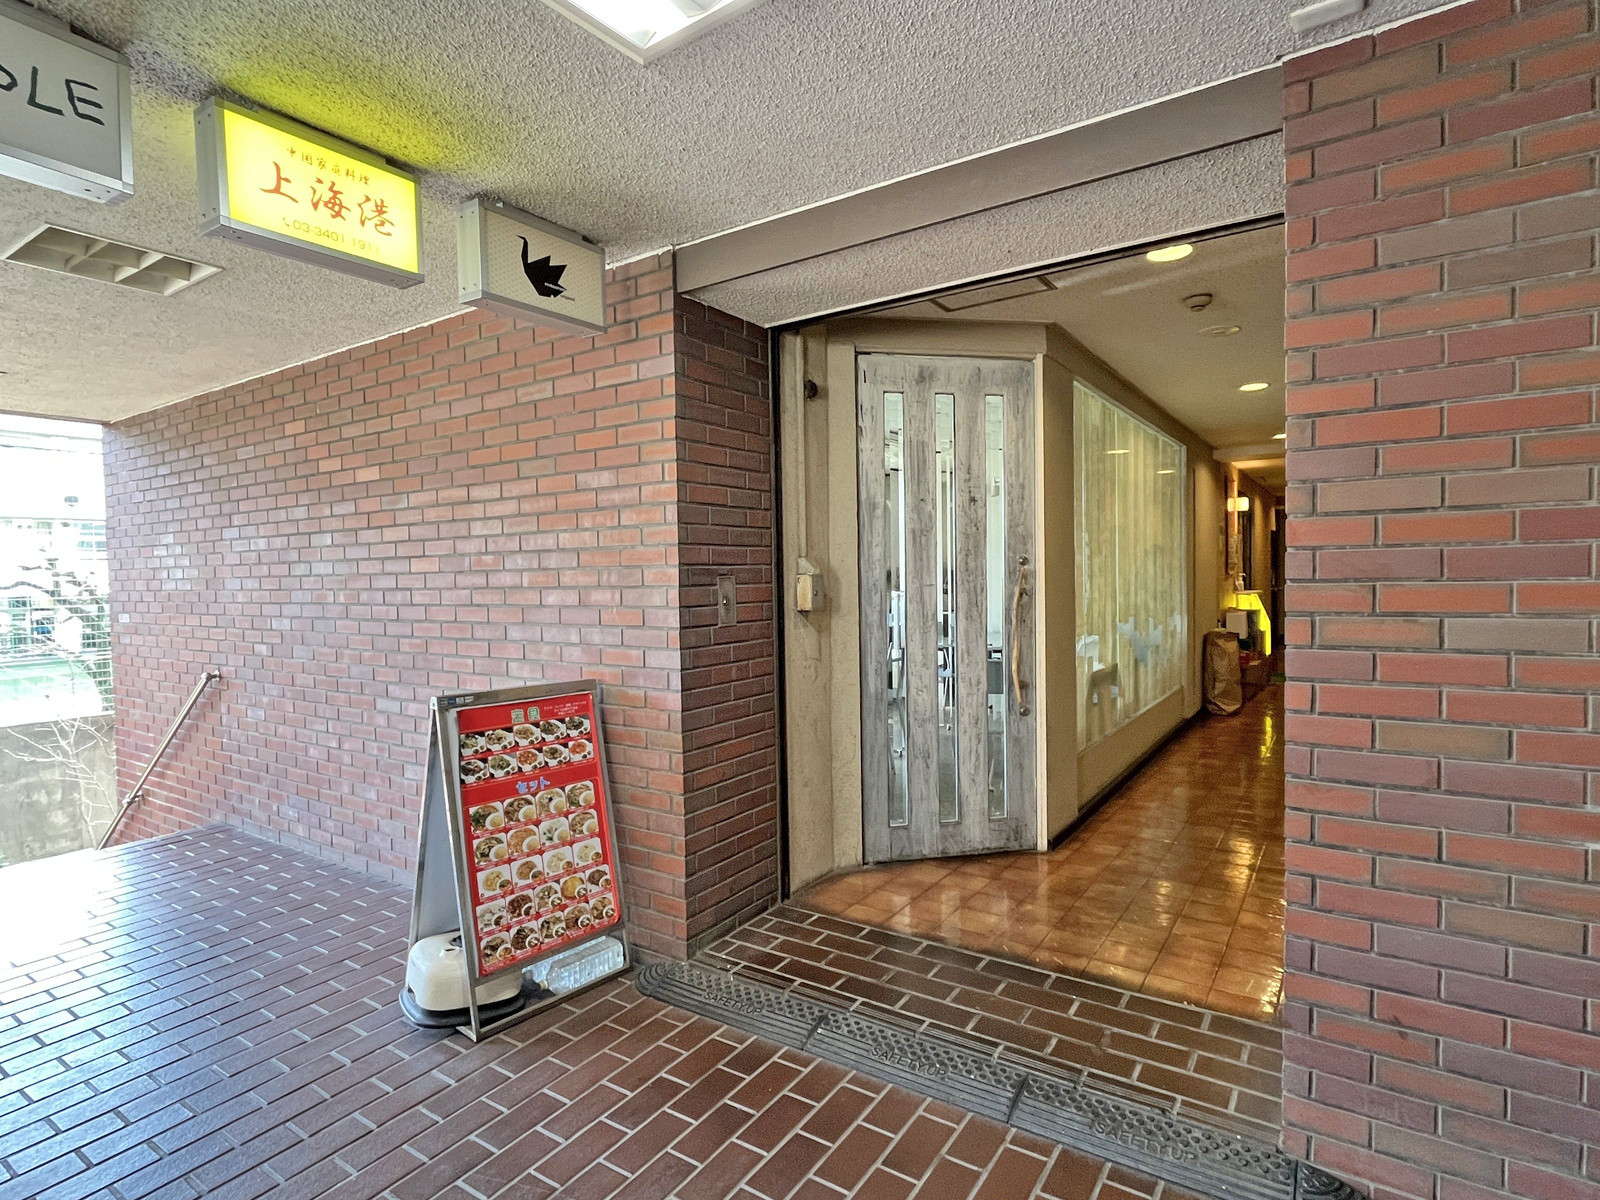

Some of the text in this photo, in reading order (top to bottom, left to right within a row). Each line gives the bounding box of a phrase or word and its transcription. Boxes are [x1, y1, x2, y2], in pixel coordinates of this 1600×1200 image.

[287, 147, 370, 185] 中国家庭料理
[259, 161, 395, 237] 上海港
[515, 775, 551, 795] セット
